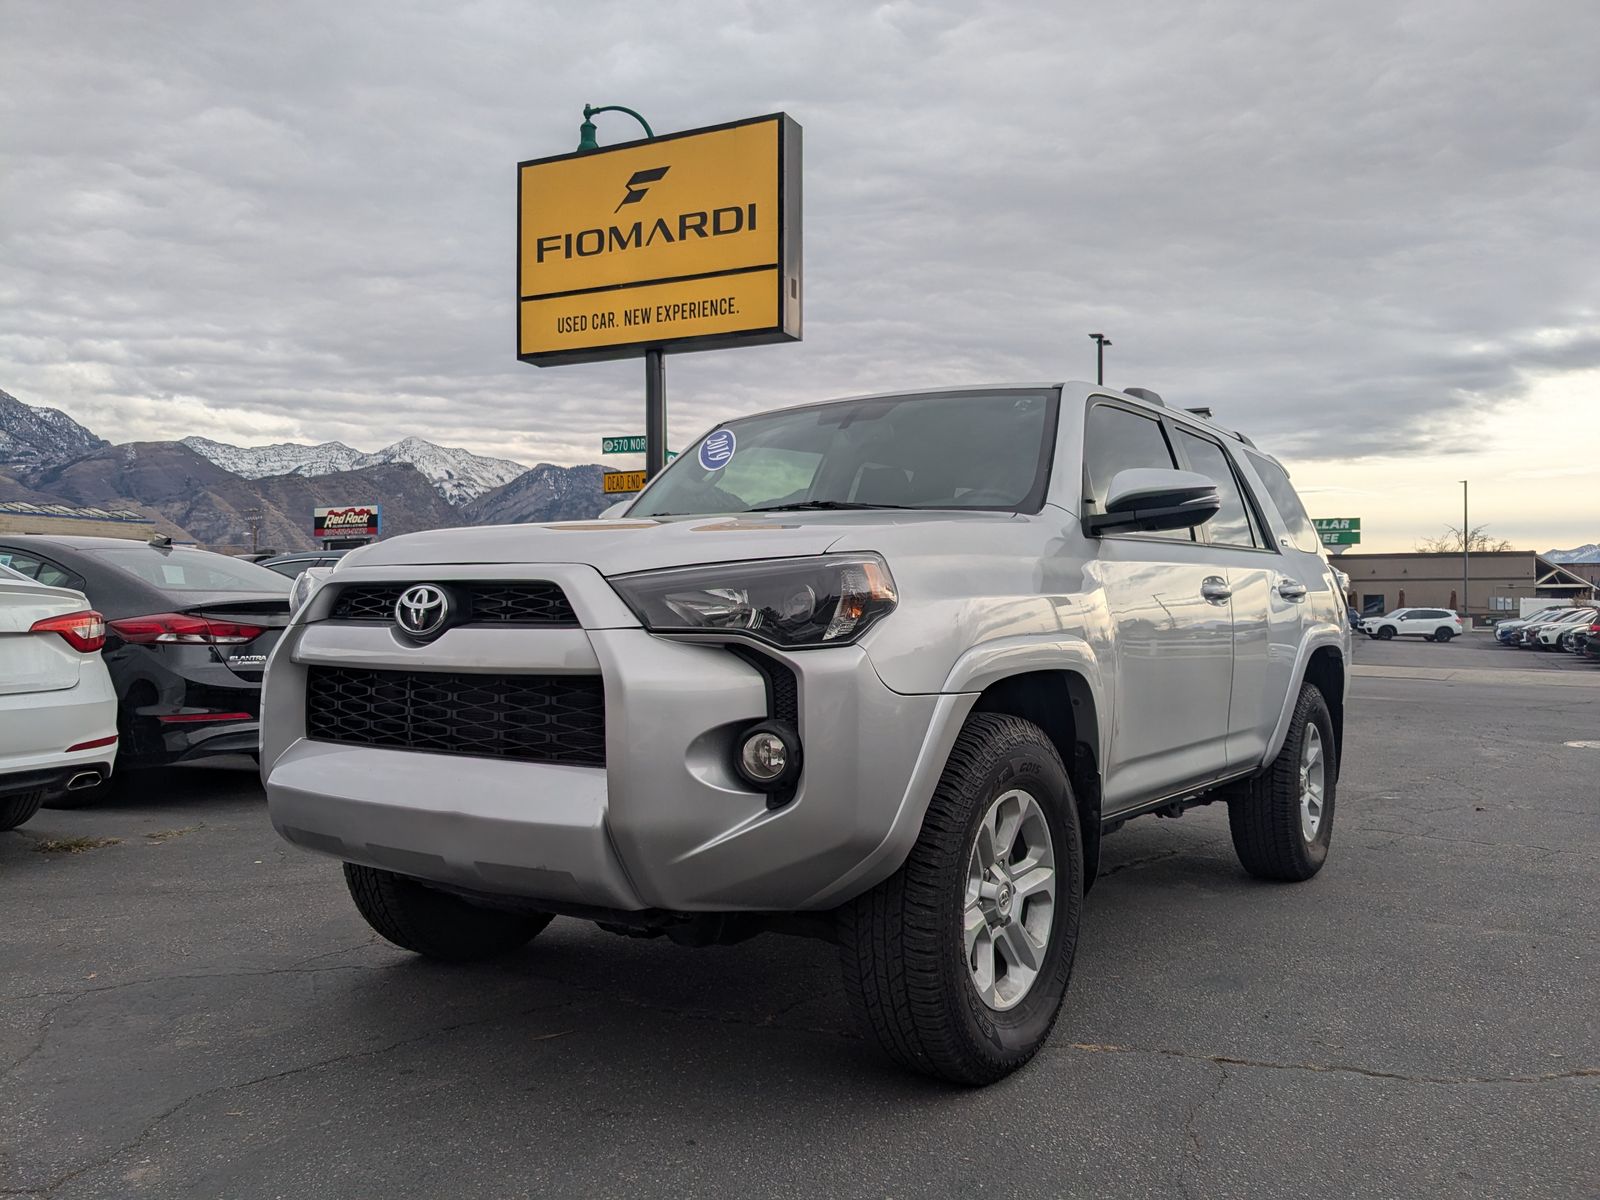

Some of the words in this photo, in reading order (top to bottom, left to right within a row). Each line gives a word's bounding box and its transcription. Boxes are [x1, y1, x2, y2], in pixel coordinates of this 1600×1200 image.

[536, 203, 757, 263] FIOMARDI
[557, 314, 588, 333] USED
[592, 311, 619, 330] CAR.
[624, 307, 652, 326] NEW
[656, 297, 740, 323] EXPERIENCE.
[613, 439, 629, 451] 570
[630, 438, 646, 450] NOR
[706, 435, 730, 460] 2019
[607, 475, 625, 490] DEAD
[627, 474, 641, 489] END
[324, 513, 345, 528] Red
[345, 512, 370, 523] Rock
[1314, 519, 1350, 529] LLAR
